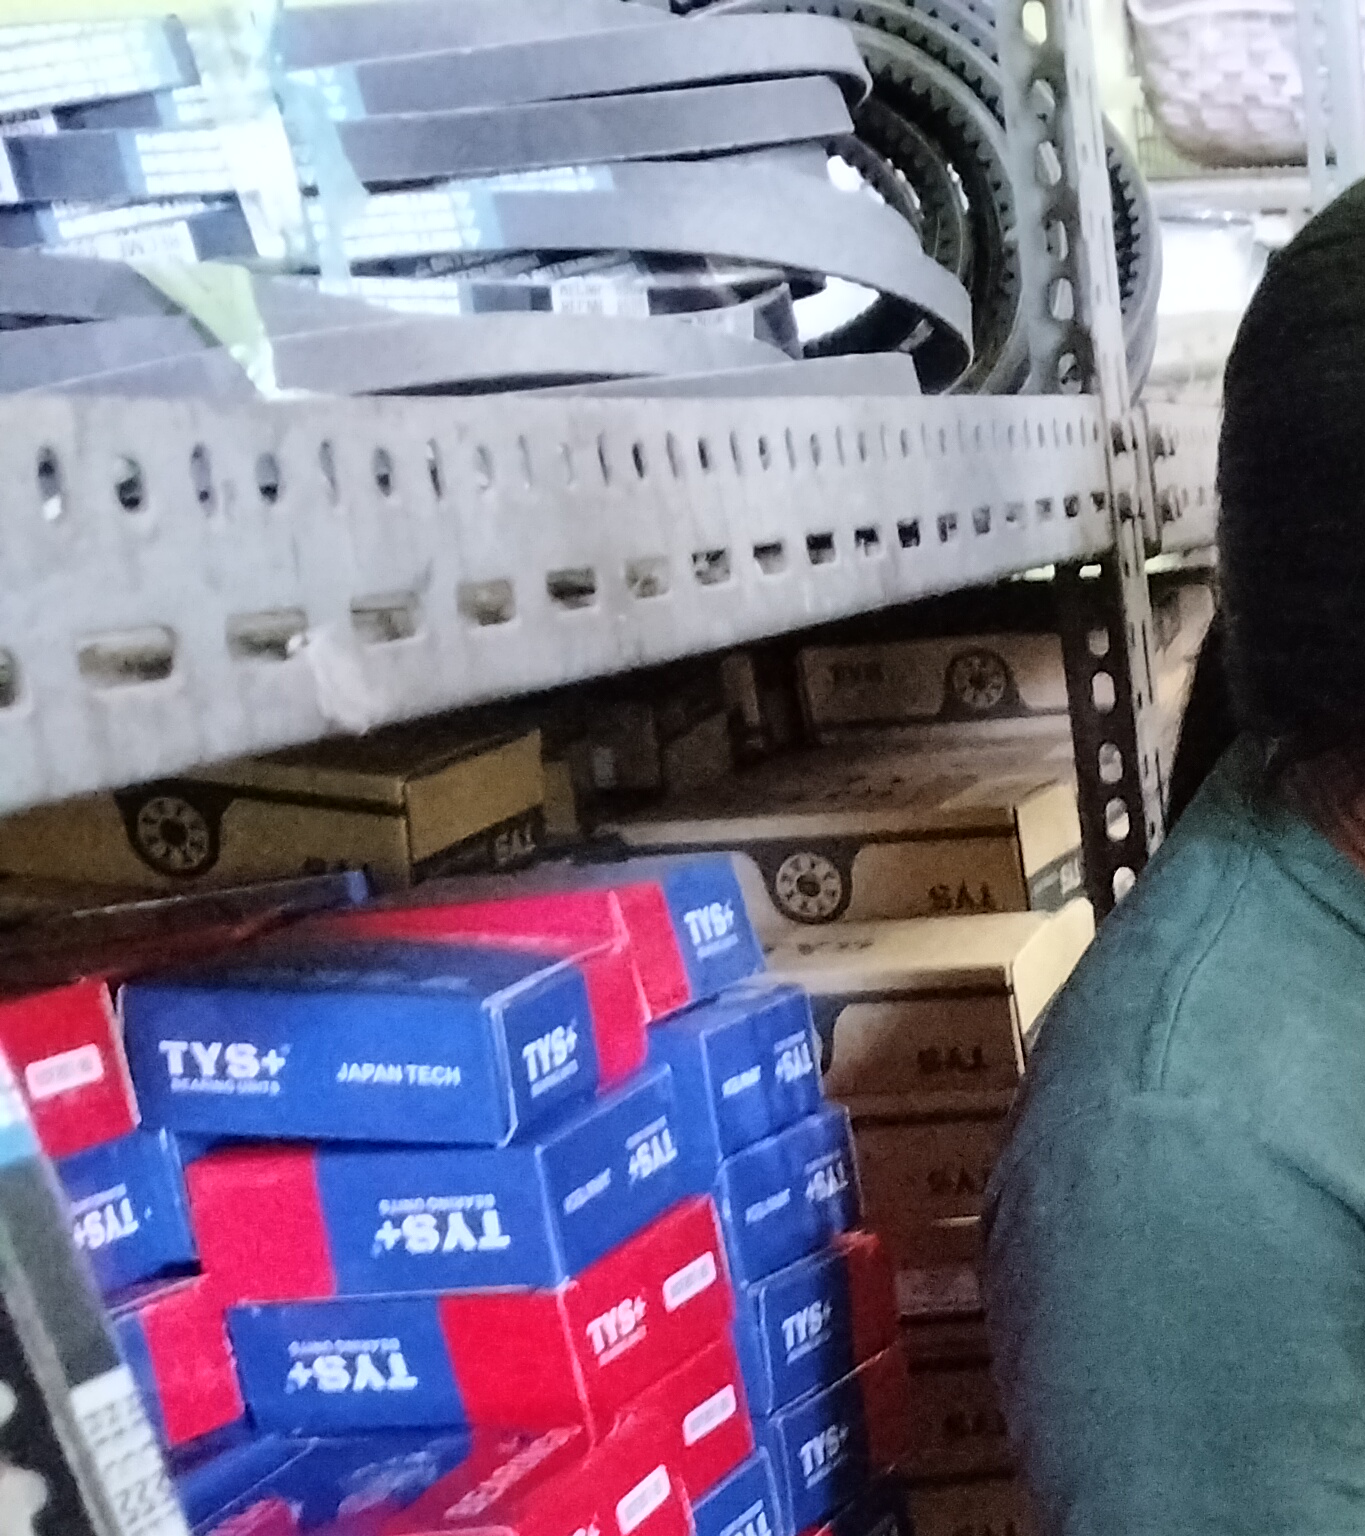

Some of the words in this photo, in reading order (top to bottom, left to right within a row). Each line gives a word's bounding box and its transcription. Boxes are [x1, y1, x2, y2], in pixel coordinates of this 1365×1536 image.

[684, 900, 736, 947] TYS+
[158, 1041, 291, 1079] TYS+
[335, 1062, 403, 1084] JAPAN
[406, 1063, 462, 1087] TECH
[522, 1020, 579, 1083] TYS+
[628, 1127, 679, 1183] TYS+
[371, 1209, 511, 1257] TYS+
[586, 1291, 647, 1355] TYS+
[285, 1352, 418, 1394] TYS+
